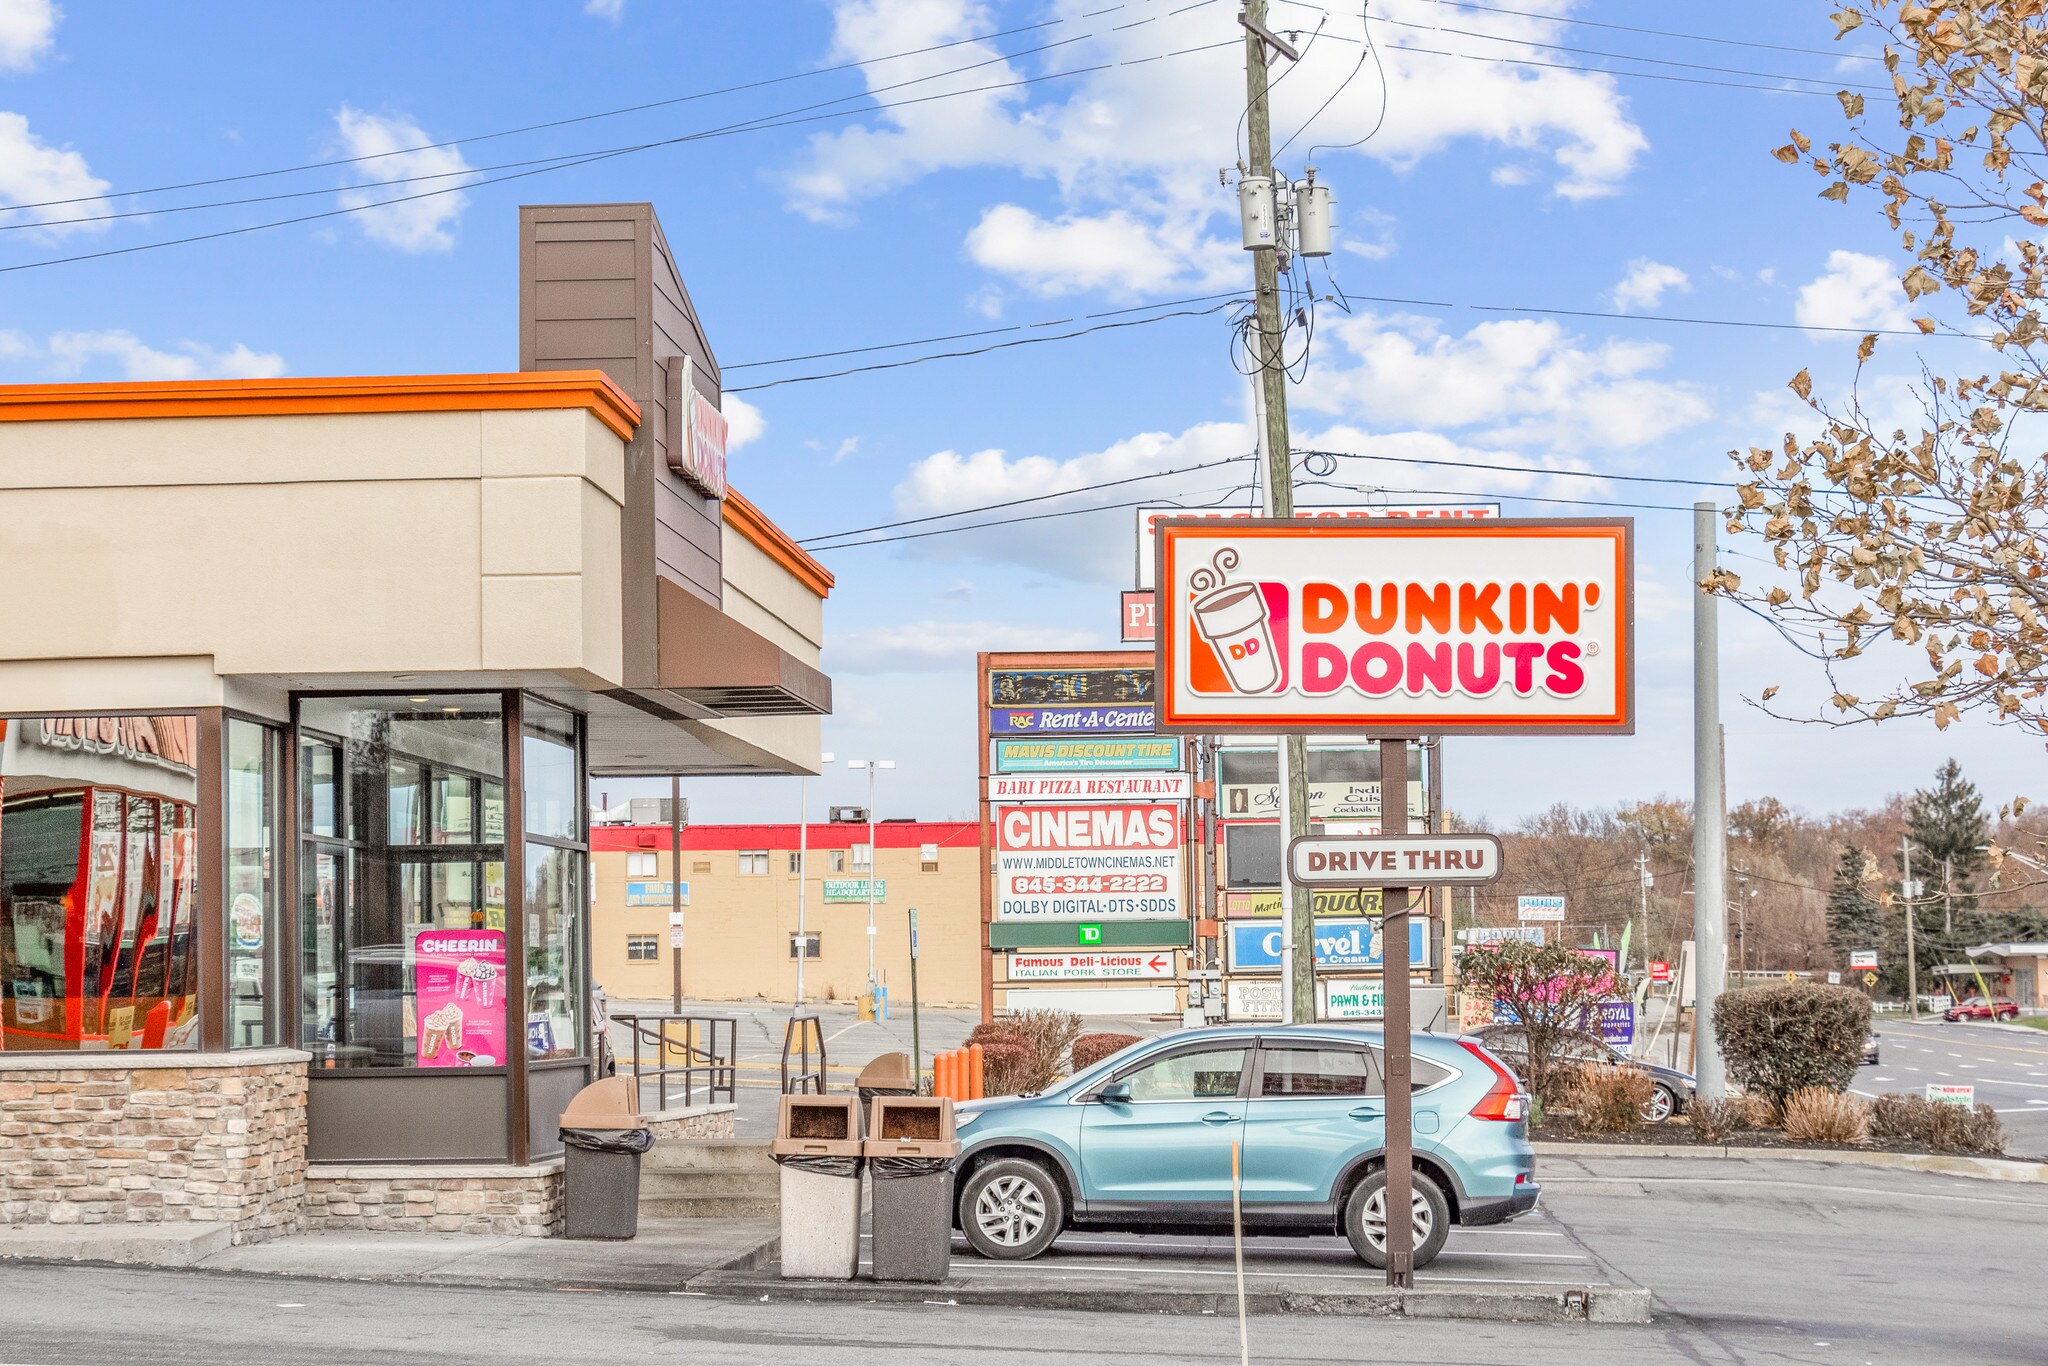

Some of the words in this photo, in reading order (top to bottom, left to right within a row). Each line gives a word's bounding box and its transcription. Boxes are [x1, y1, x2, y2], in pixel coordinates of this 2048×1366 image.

[1302, 582, 1600, 635] DUNKIN'
[1229, 638, 1260, 660] DD
[1302, 641, 1585, 694] DONUTS
[1010, 714, 1034, 729] RAC
[1004, 744, 1054, 758] MAVIS
[1056, 744, 1137, 758] DISCOUNT
[1137, 743, 1173, 757] TIRE
[1043, 759, 1079, 767] America's
[1079, 759, 1094, 767] Tire
[1094, 758, 1134, 766] Discounter
[996, 780, 1035, 795] BARI
[1038, 780, 1081, 795] PIZZA
[1086, 779, 1182, 794] RESTAURANT
[1349, 786, 1382, 794] Indi
[1344, 795, 1381, 803] Cuis
[1333, 805, 1372, 813] Cocktails
[1003, 809, 1175, 848] CINEMAS
[1003, 855, 1176, 870] WWW.MIDDLETOWNCINEMAS.NET
[1308, 851, 1396, 871] DRIVE
[1403, 849, 1484, 870] THRU
[825, 881, 859, 889] OUTDOOR
[861, 881, 884, 889] LIVNG
[1015, 876, 1164, 893] 845-344-2222
[1003, 900, 1049, 914] DOLBY
[1228, 899, 1251, 910] LOTTO
[1314, 895, 1382, 913] QUOR
[1082, 927, 1099, 940] TD
[1262, 930, 1362, 956] Cvel
[1015, 957, 1063, 967] Famous
[1070, 956, 1142, 967] Deli-Licious
[1329, 955, 1369, 964] Cream
[1015, 969, 1058, 977] ITALIAN
[1102, 968, 1142, 976] STORE
[1242, 1000, 1283, 1012] FITN
[1331, 994, 1359, 1007] PAWN
[1362, 994, 1369, 1006] &
